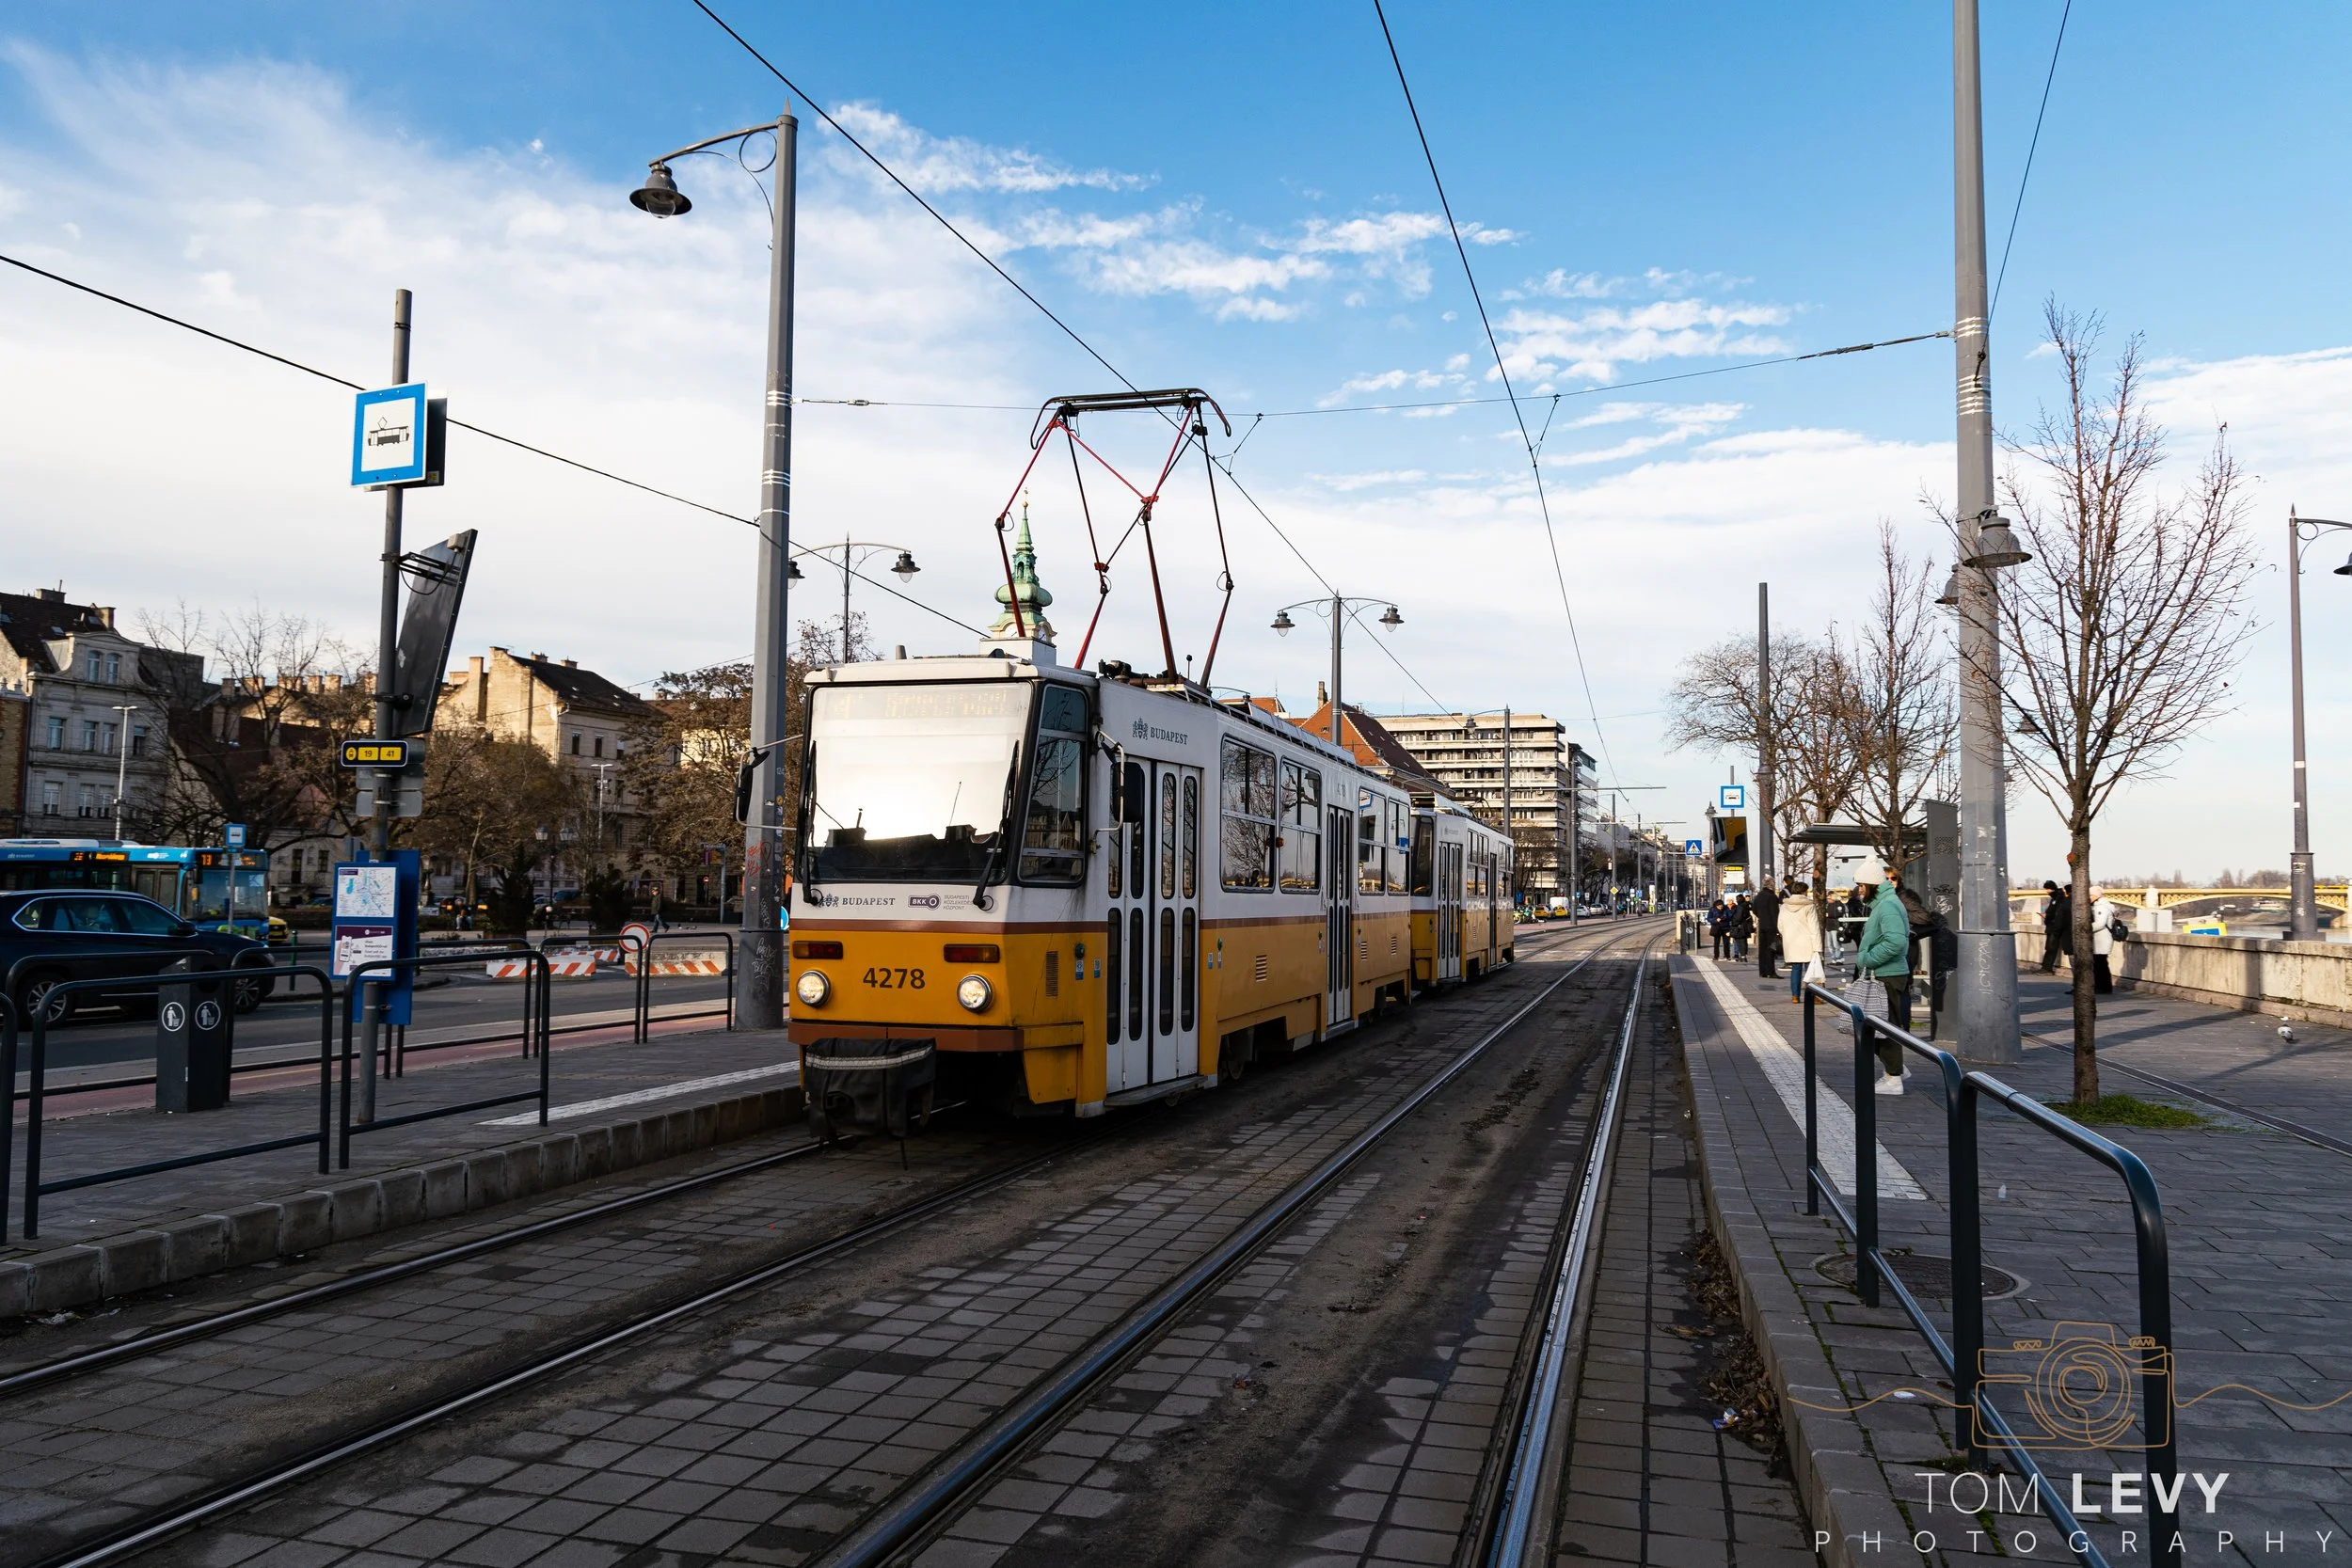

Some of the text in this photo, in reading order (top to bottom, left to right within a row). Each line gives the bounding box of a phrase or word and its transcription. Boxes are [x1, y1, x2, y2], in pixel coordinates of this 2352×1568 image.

[1150, 726, 1189, 745] BUDAPEST
[842, 897, 896, 906] BUDAPEST
[863, 967, 926, 990] 4278
